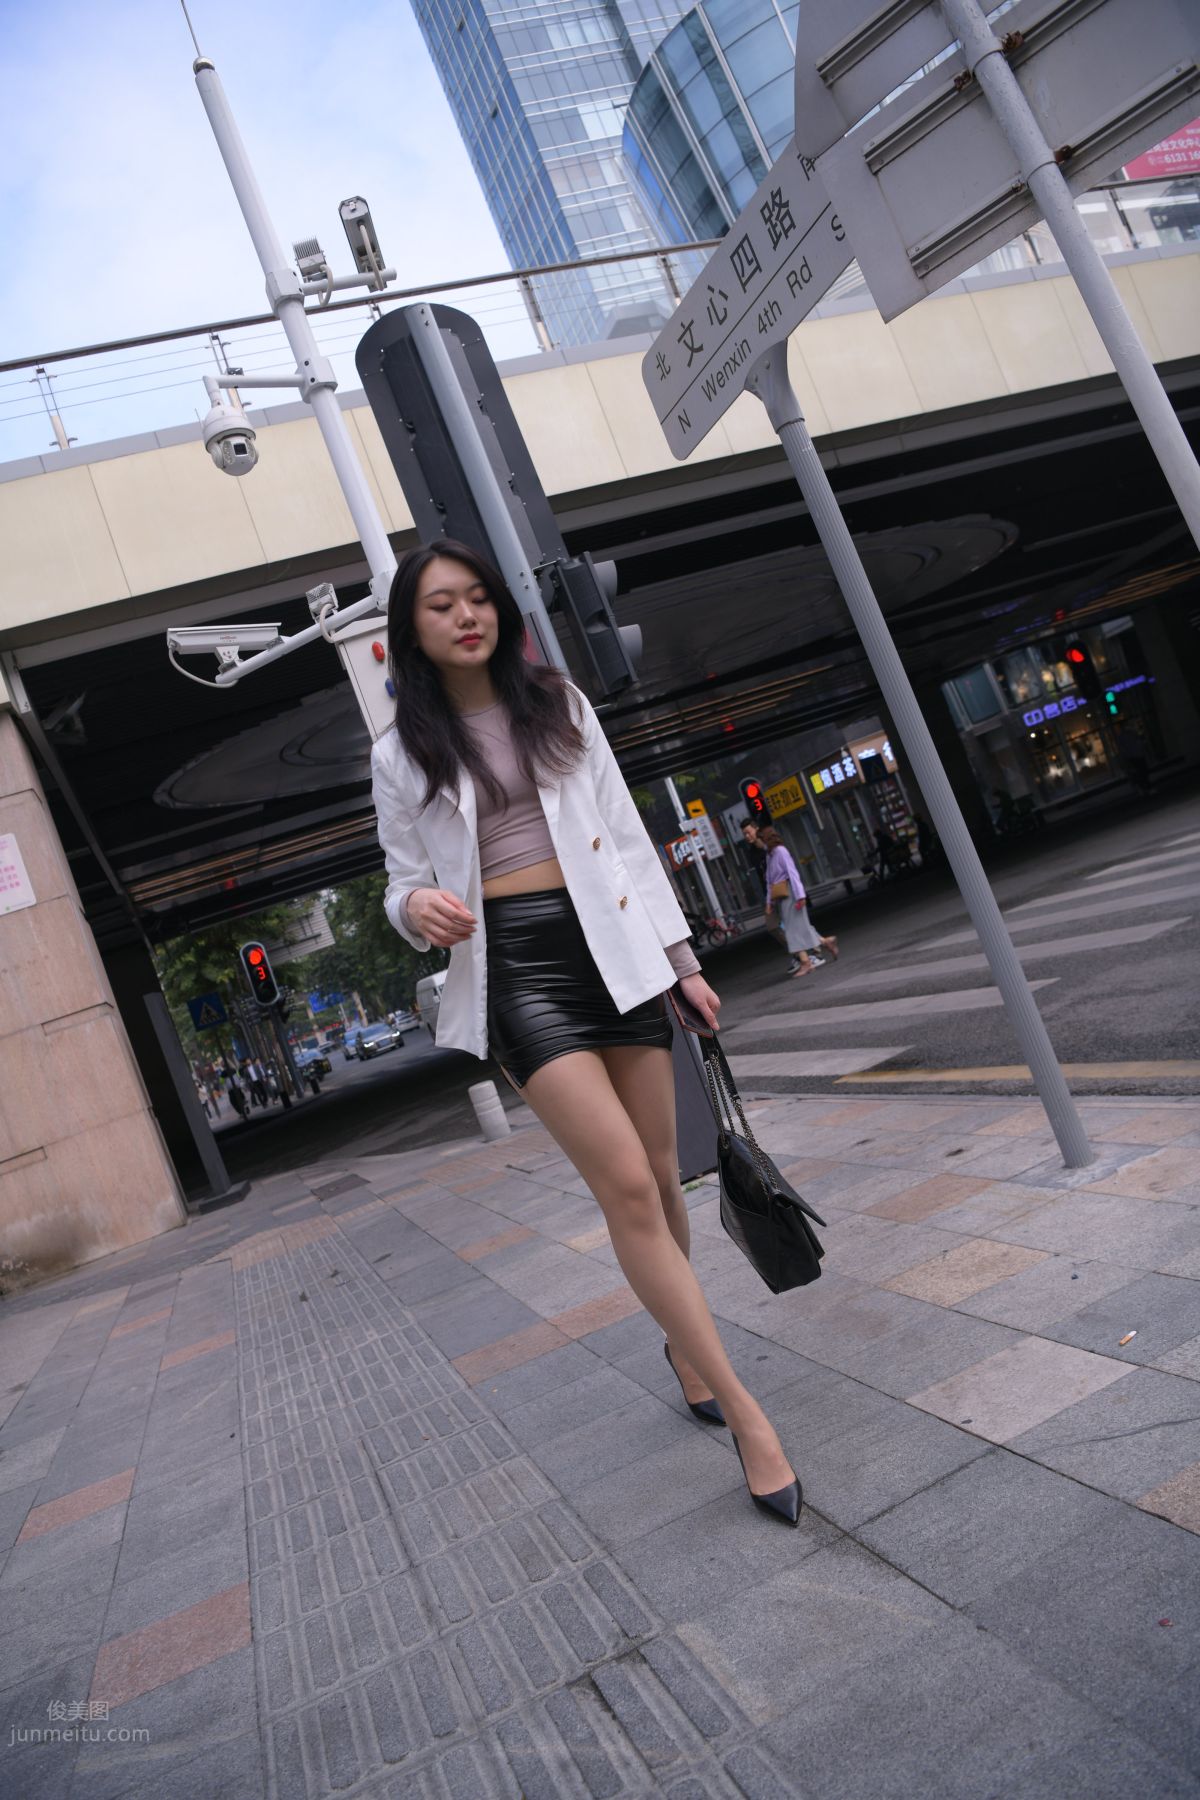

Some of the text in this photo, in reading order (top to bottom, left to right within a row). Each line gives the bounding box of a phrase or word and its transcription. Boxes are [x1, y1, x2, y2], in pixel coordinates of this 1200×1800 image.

[655, 351, 672, 381] 北
[677, 187, 797, 369] 文心四路
[677, 214, 847, 434] N Wenxin 4th Rd S
[753, 799, 763, 811] 3
[257, 966, 266, 980] 3
